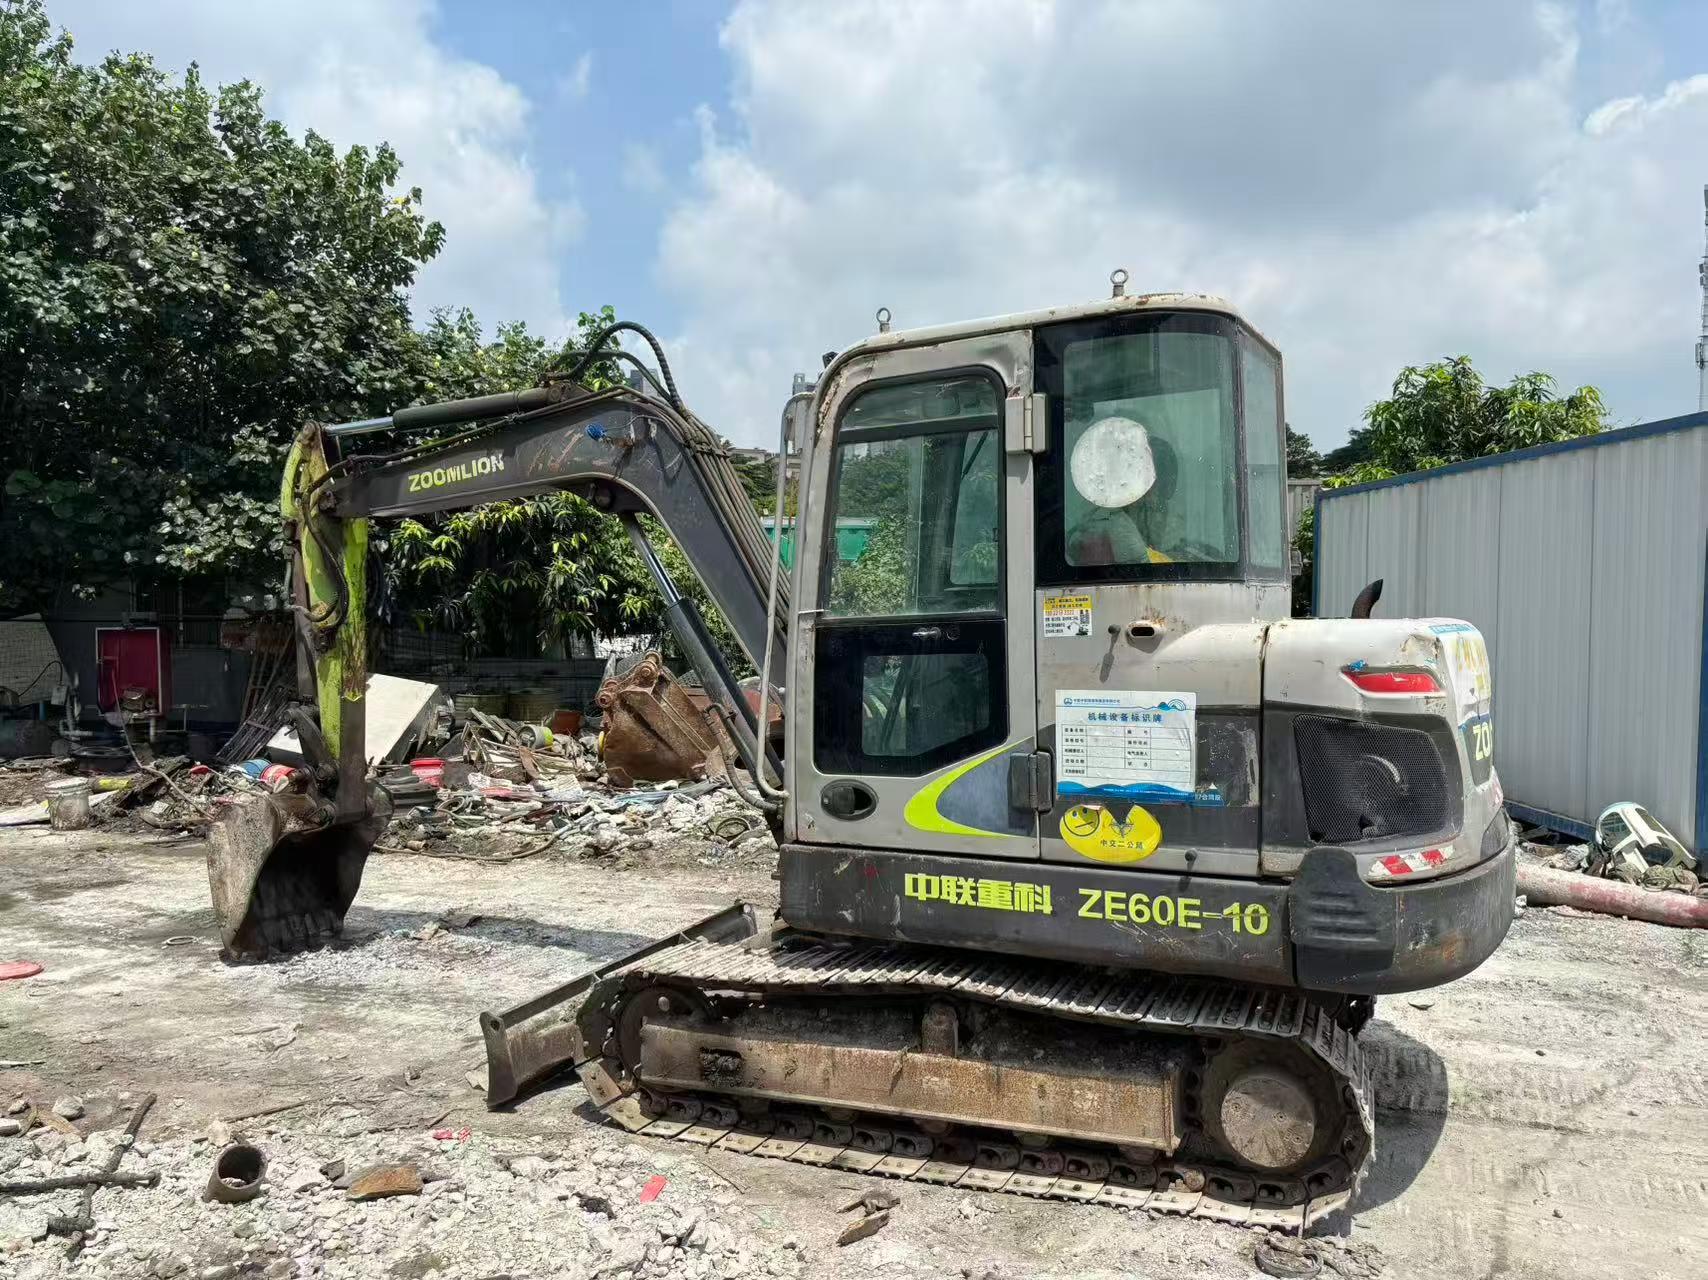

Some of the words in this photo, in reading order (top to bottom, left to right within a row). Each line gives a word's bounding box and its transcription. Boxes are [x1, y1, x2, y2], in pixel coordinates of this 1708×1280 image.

[408, 452, 505, 492] ZOOMLION
[1087, 711, 1162, 723] 机械设备标识牌
[904, 872, 1053, 915] 中联重科
[1077, 888, 1270, 936] ZE60E-10
